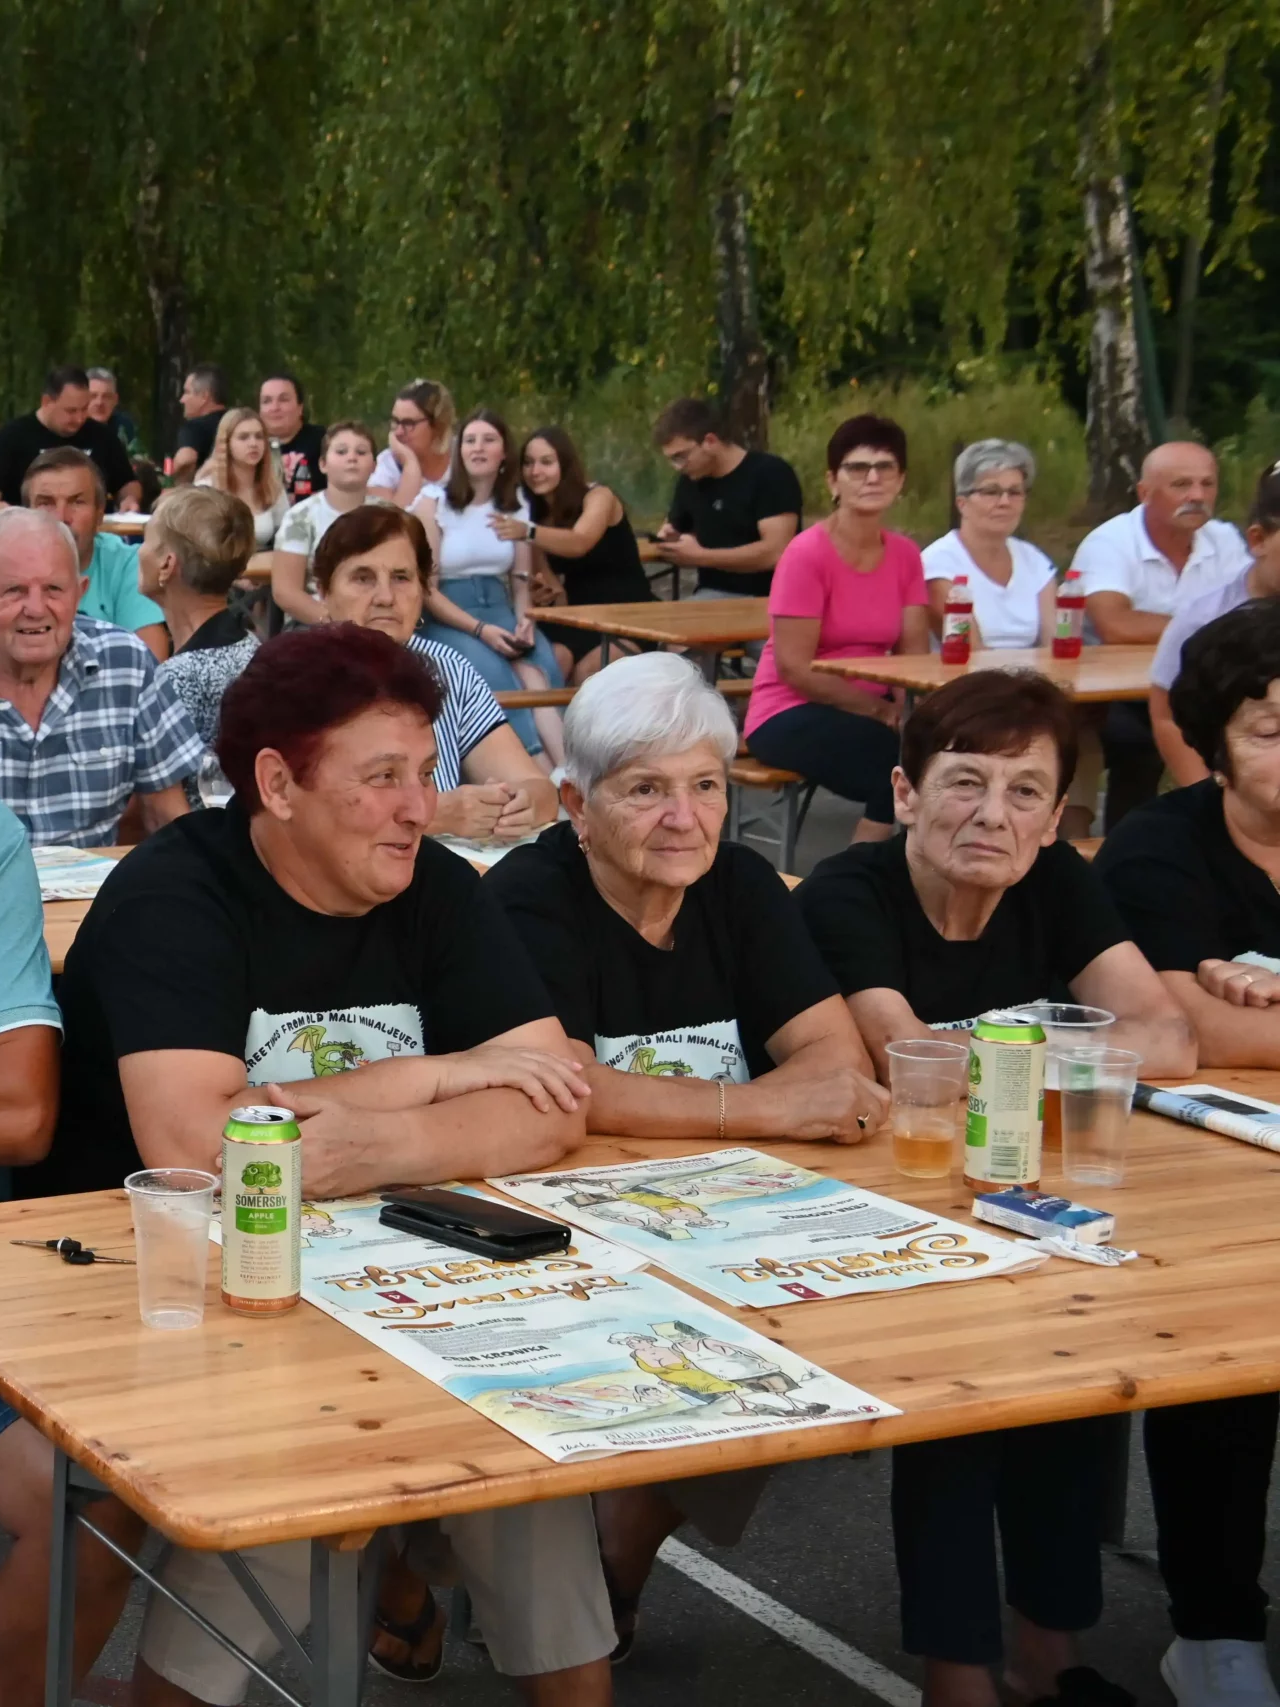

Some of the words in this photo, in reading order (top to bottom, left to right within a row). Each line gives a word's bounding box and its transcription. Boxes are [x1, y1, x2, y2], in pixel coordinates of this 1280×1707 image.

[281, 1015, 306, 1034] FROM
[306, 1012, 324, 1025] OLD
[329, 1013, 357, 1023] MALI
[656, 1034, 683, 1044] MALI
[235, 1194, 288, 1208] SOMERSBY
[248, 1212, 275, 1220] APPLE
[721, 1233, 990, 1283] Smoliga
[480, 1345, 550, 1360] KRONIKA
